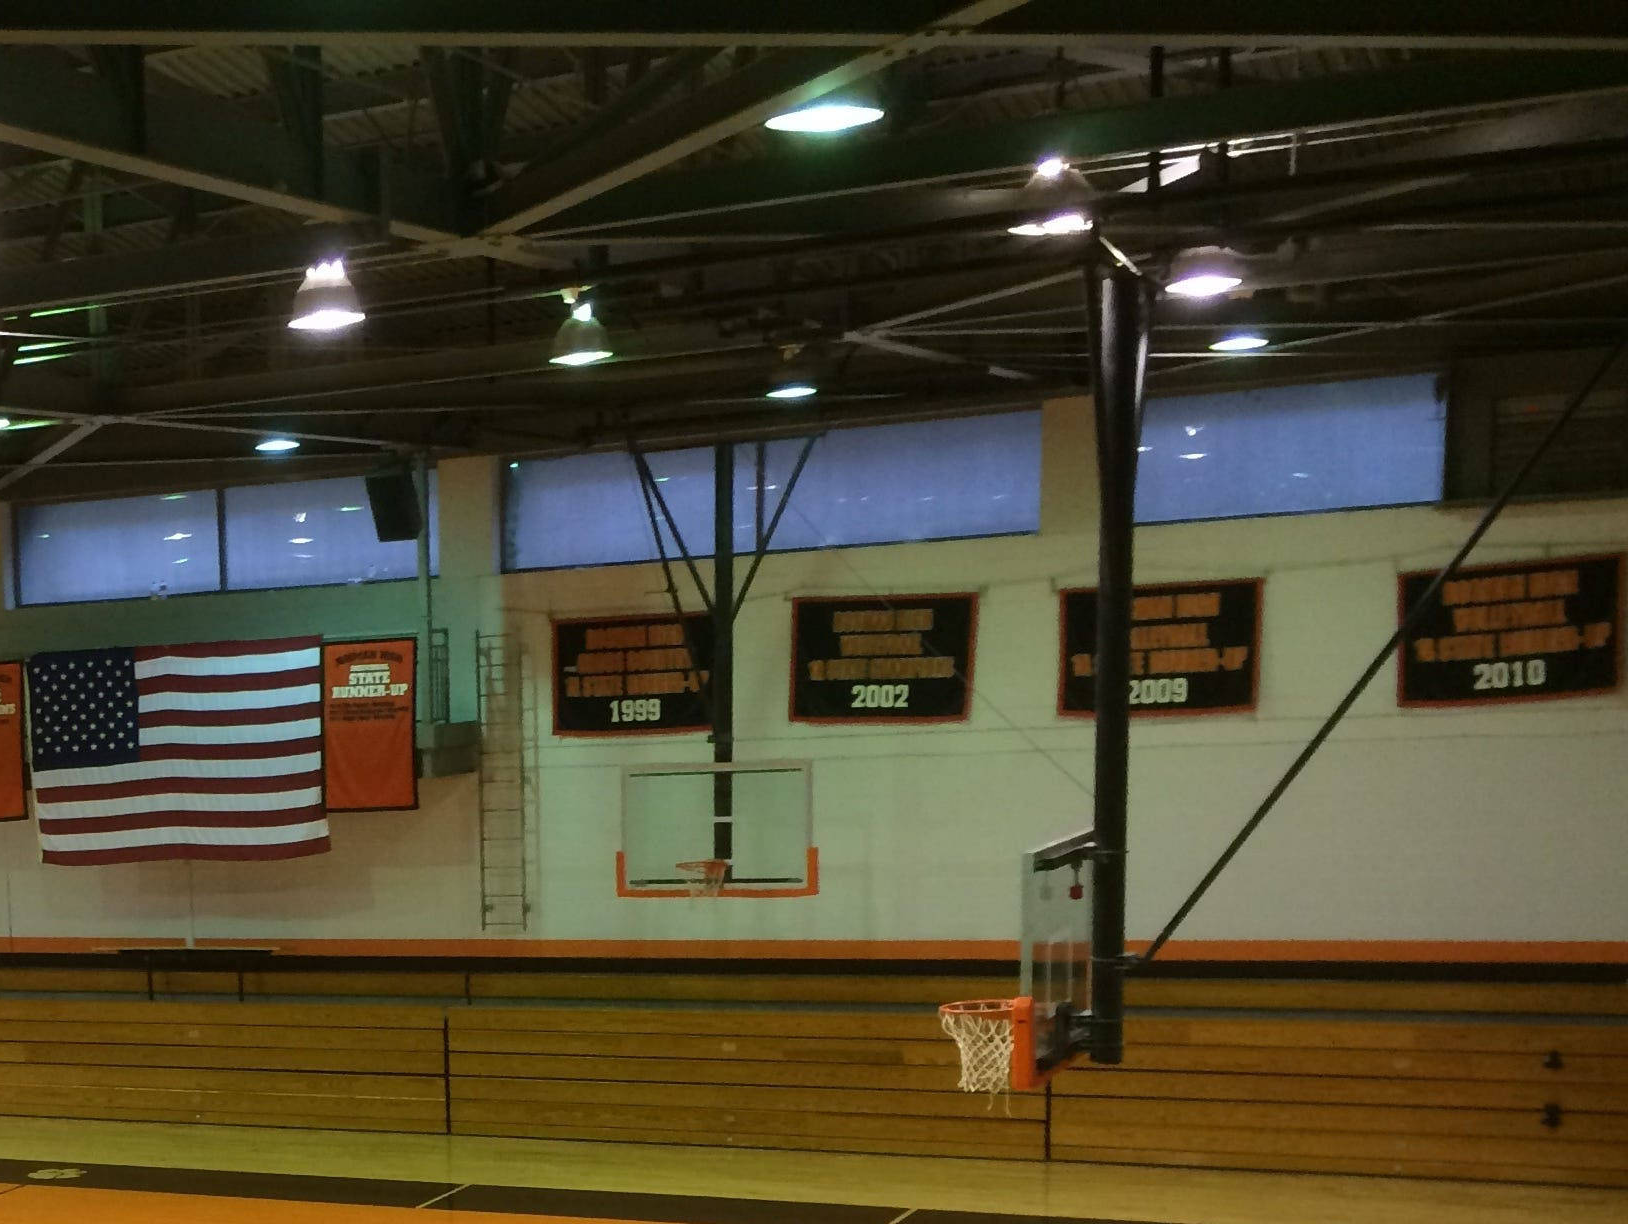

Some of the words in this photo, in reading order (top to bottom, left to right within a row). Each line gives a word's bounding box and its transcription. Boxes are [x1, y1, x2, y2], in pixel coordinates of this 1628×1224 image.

[1473, 659, 1546, 690] 2010
[850, 684, 909, 709] 2002
[1129, 677, 1189, 704] 2009
[609, 698, 661, 723] 1999
